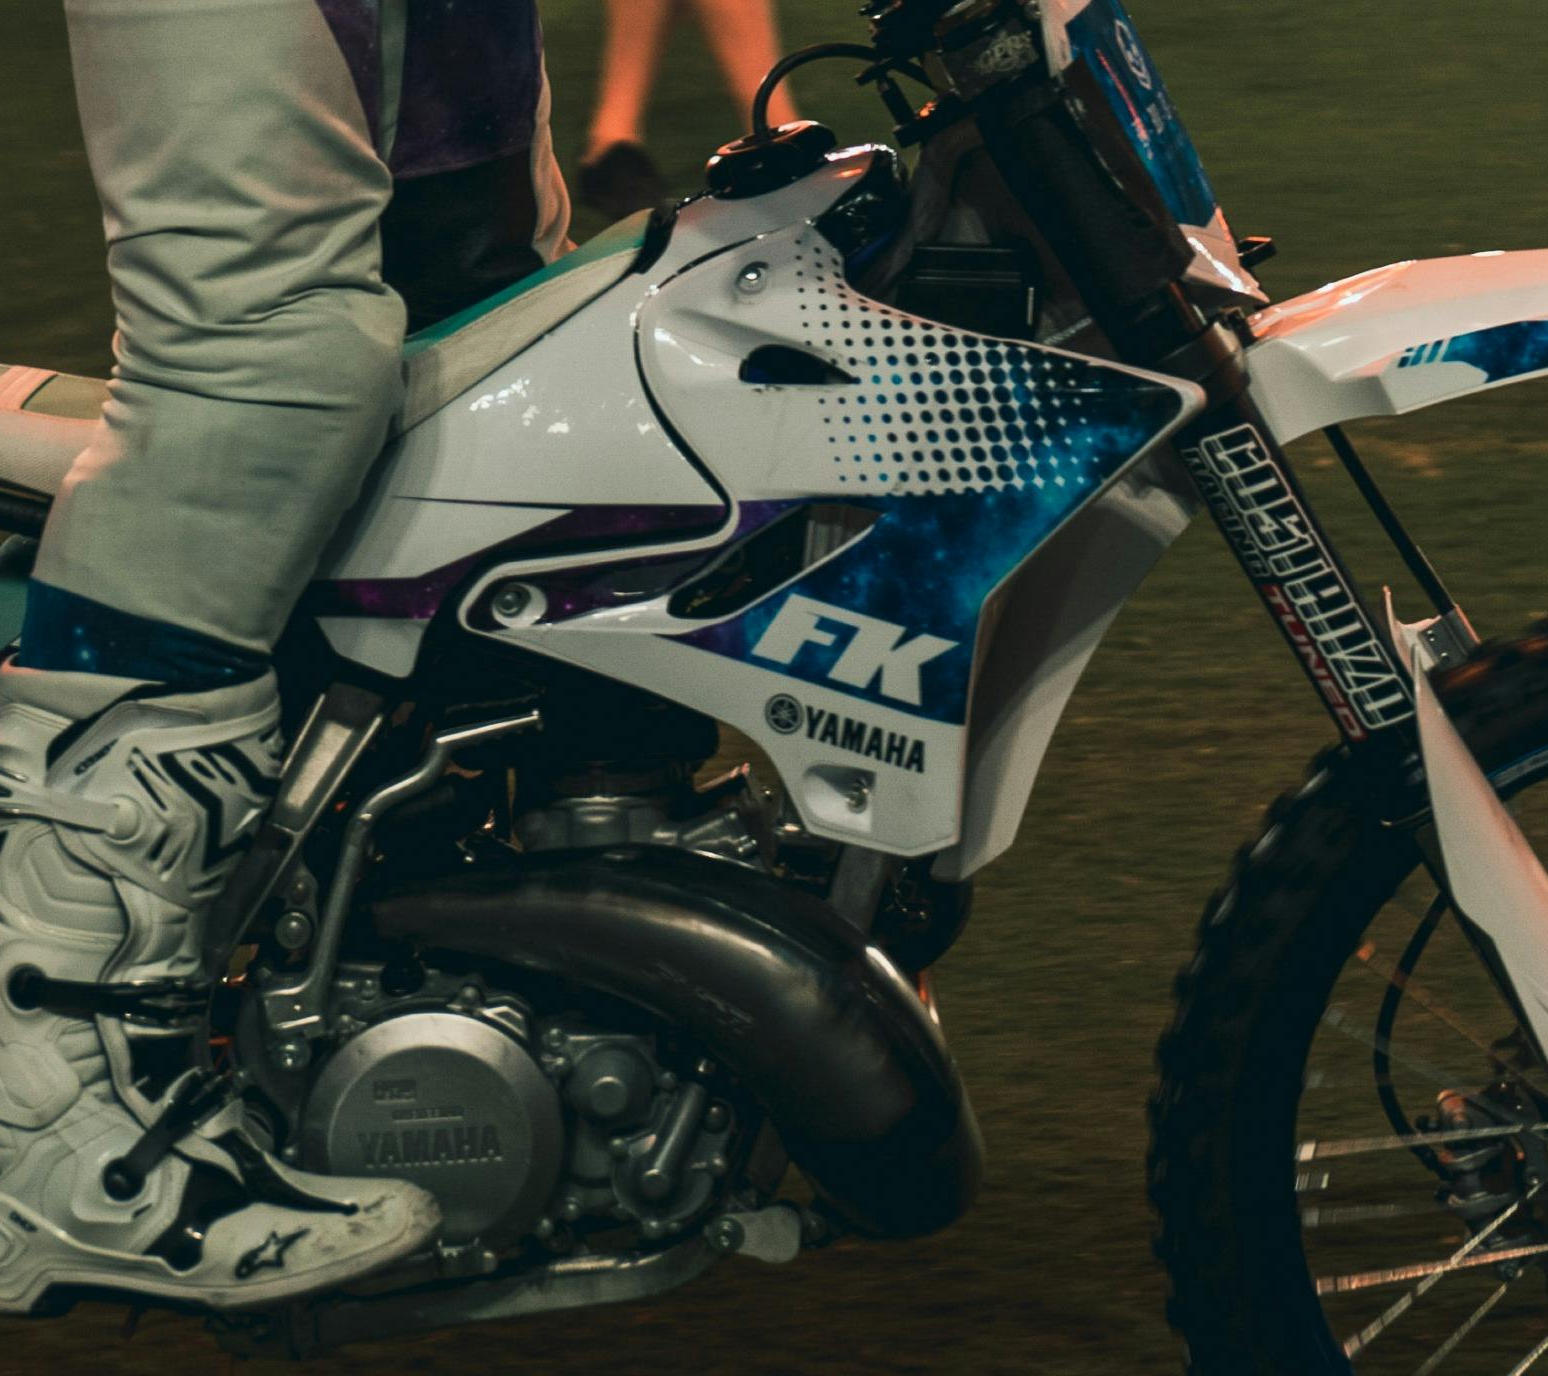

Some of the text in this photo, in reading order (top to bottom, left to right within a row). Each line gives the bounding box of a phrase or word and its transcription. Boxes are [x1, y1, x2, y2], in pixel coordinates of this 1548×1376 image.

[753, 594, 960, 707] FK
[1263, 583, 1367, 740] TUNED
[804, 710, 926, 774] YAMAHA
[356, 1124, 503, 1169] YAMAHA
